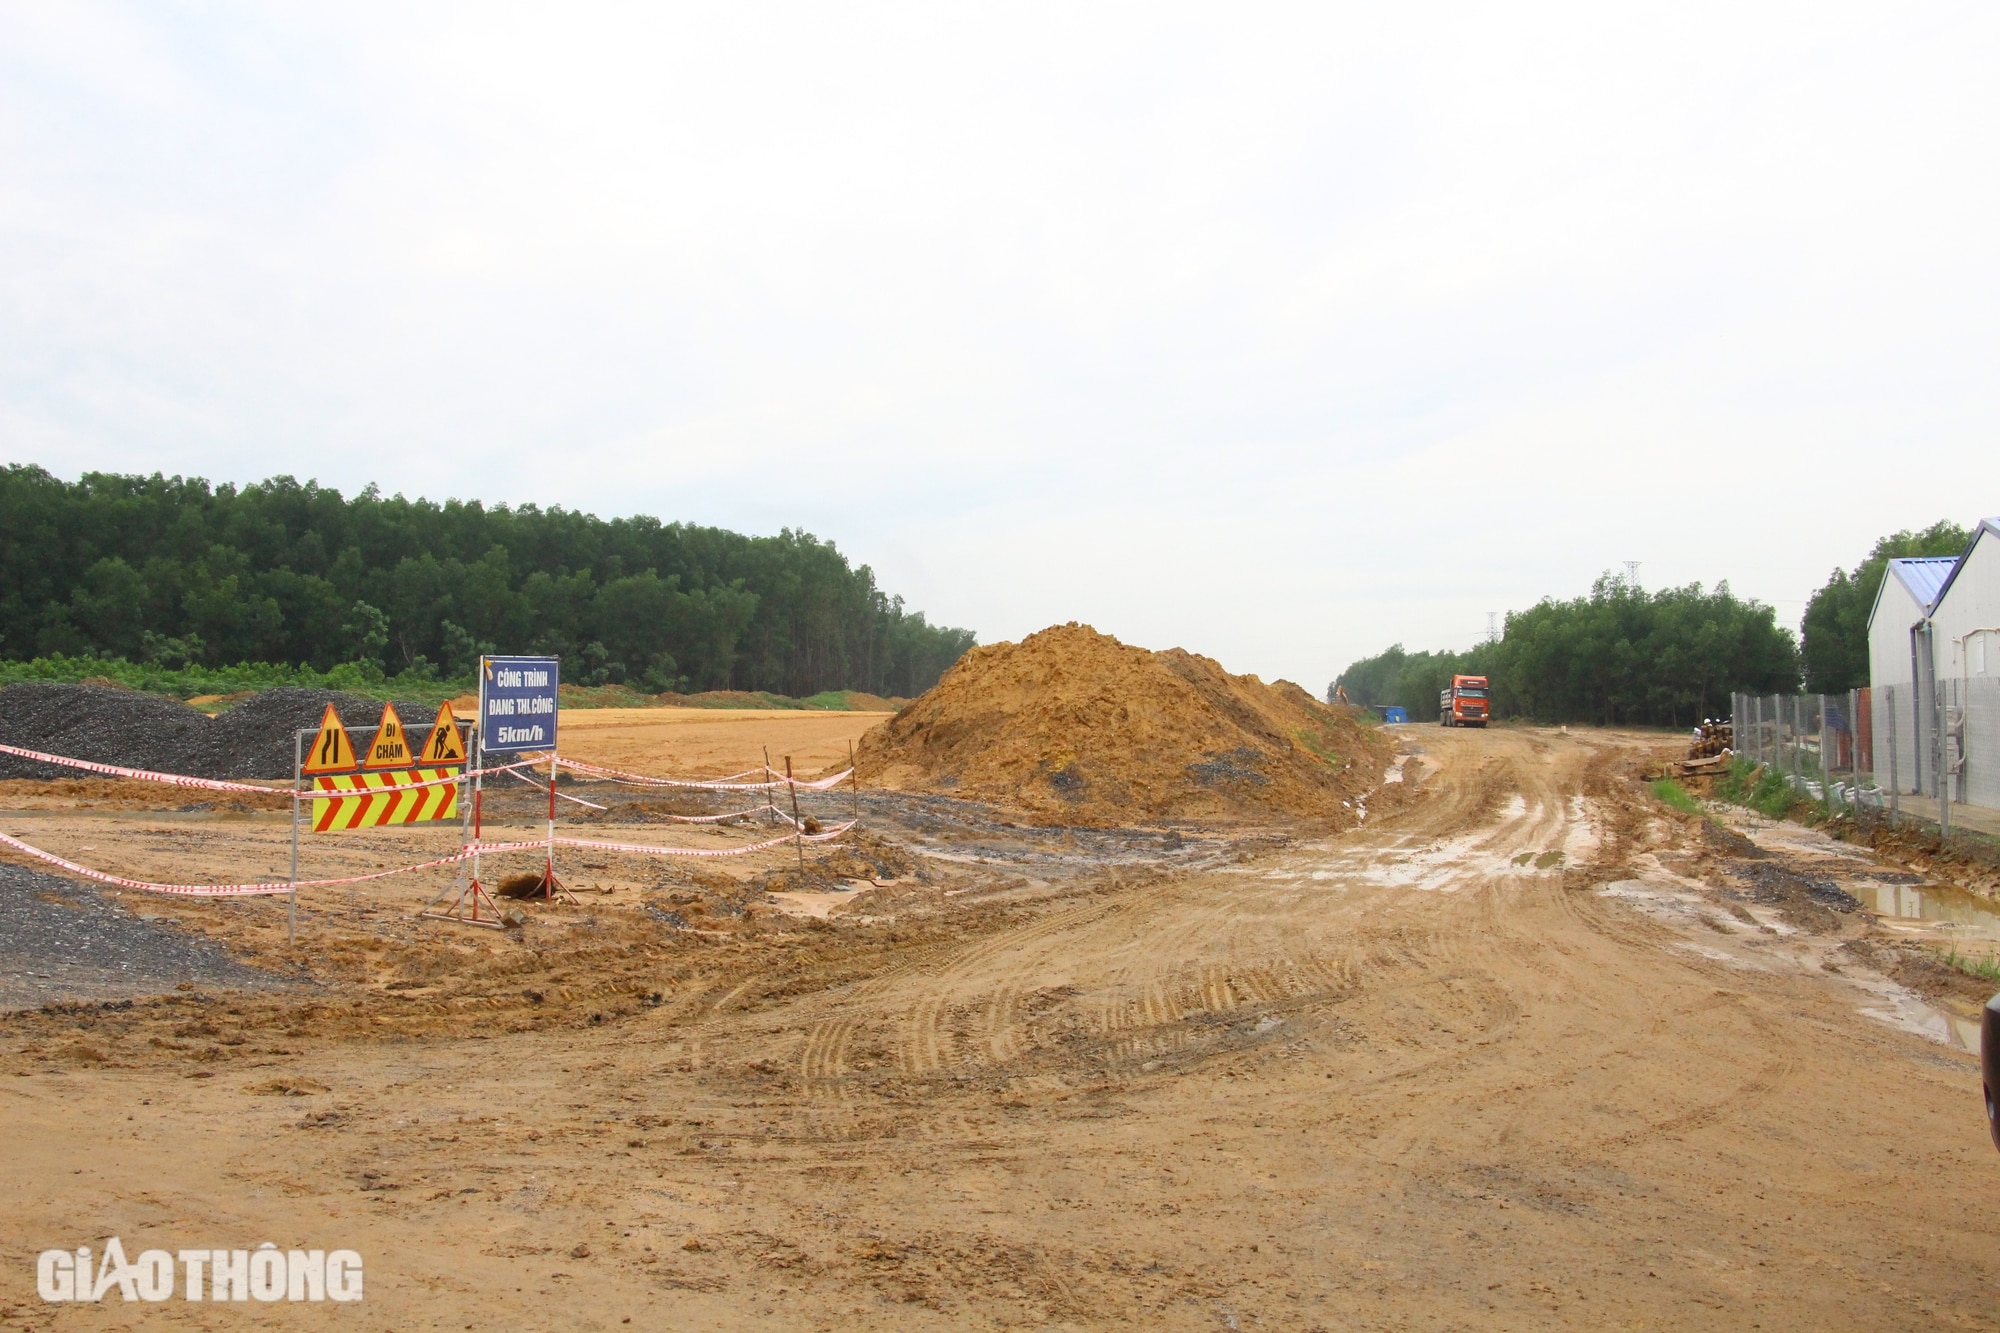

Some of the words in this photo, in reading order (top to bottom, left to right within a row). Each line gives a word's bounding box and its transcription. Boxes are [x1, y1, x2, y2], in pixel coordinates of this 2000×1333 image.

[497, 667, 522, 687] CÔNG
[523, 667, 548, 687] TRÌNH
[489, 698, 515, 716] ĐANG
[516, 698, 530, 714] THI
[531, 694, 554, 714] CÔNG
[386, 722, 396, 738] ĐI
[498, 725, 544, 744] 5km/h
[376, 740, 403, 762] CHẬM
